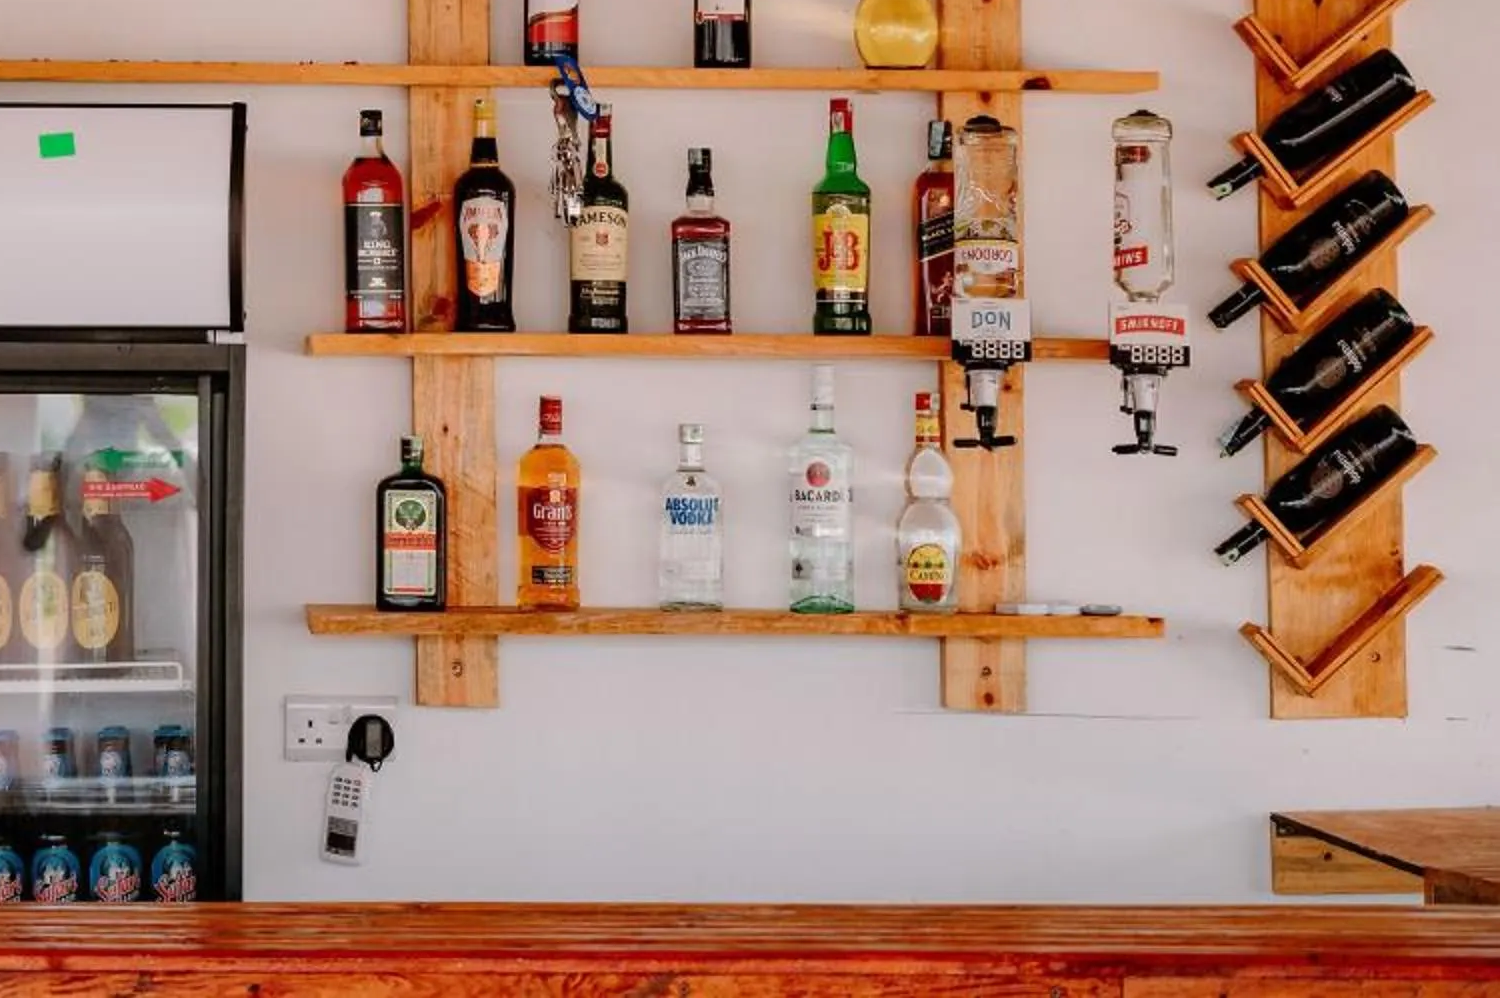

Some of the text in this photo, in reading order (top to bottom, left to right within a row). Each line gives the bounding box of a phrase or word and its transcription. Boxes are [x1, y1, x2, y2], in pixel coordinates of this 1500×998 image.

[971, 311, 1011, 330] DON
[1119, 318, 1178, 332] SMIRNOFF
[665, 497, 719, 511] ABSOLUT
[670, 511, 713, 525] VODKA
